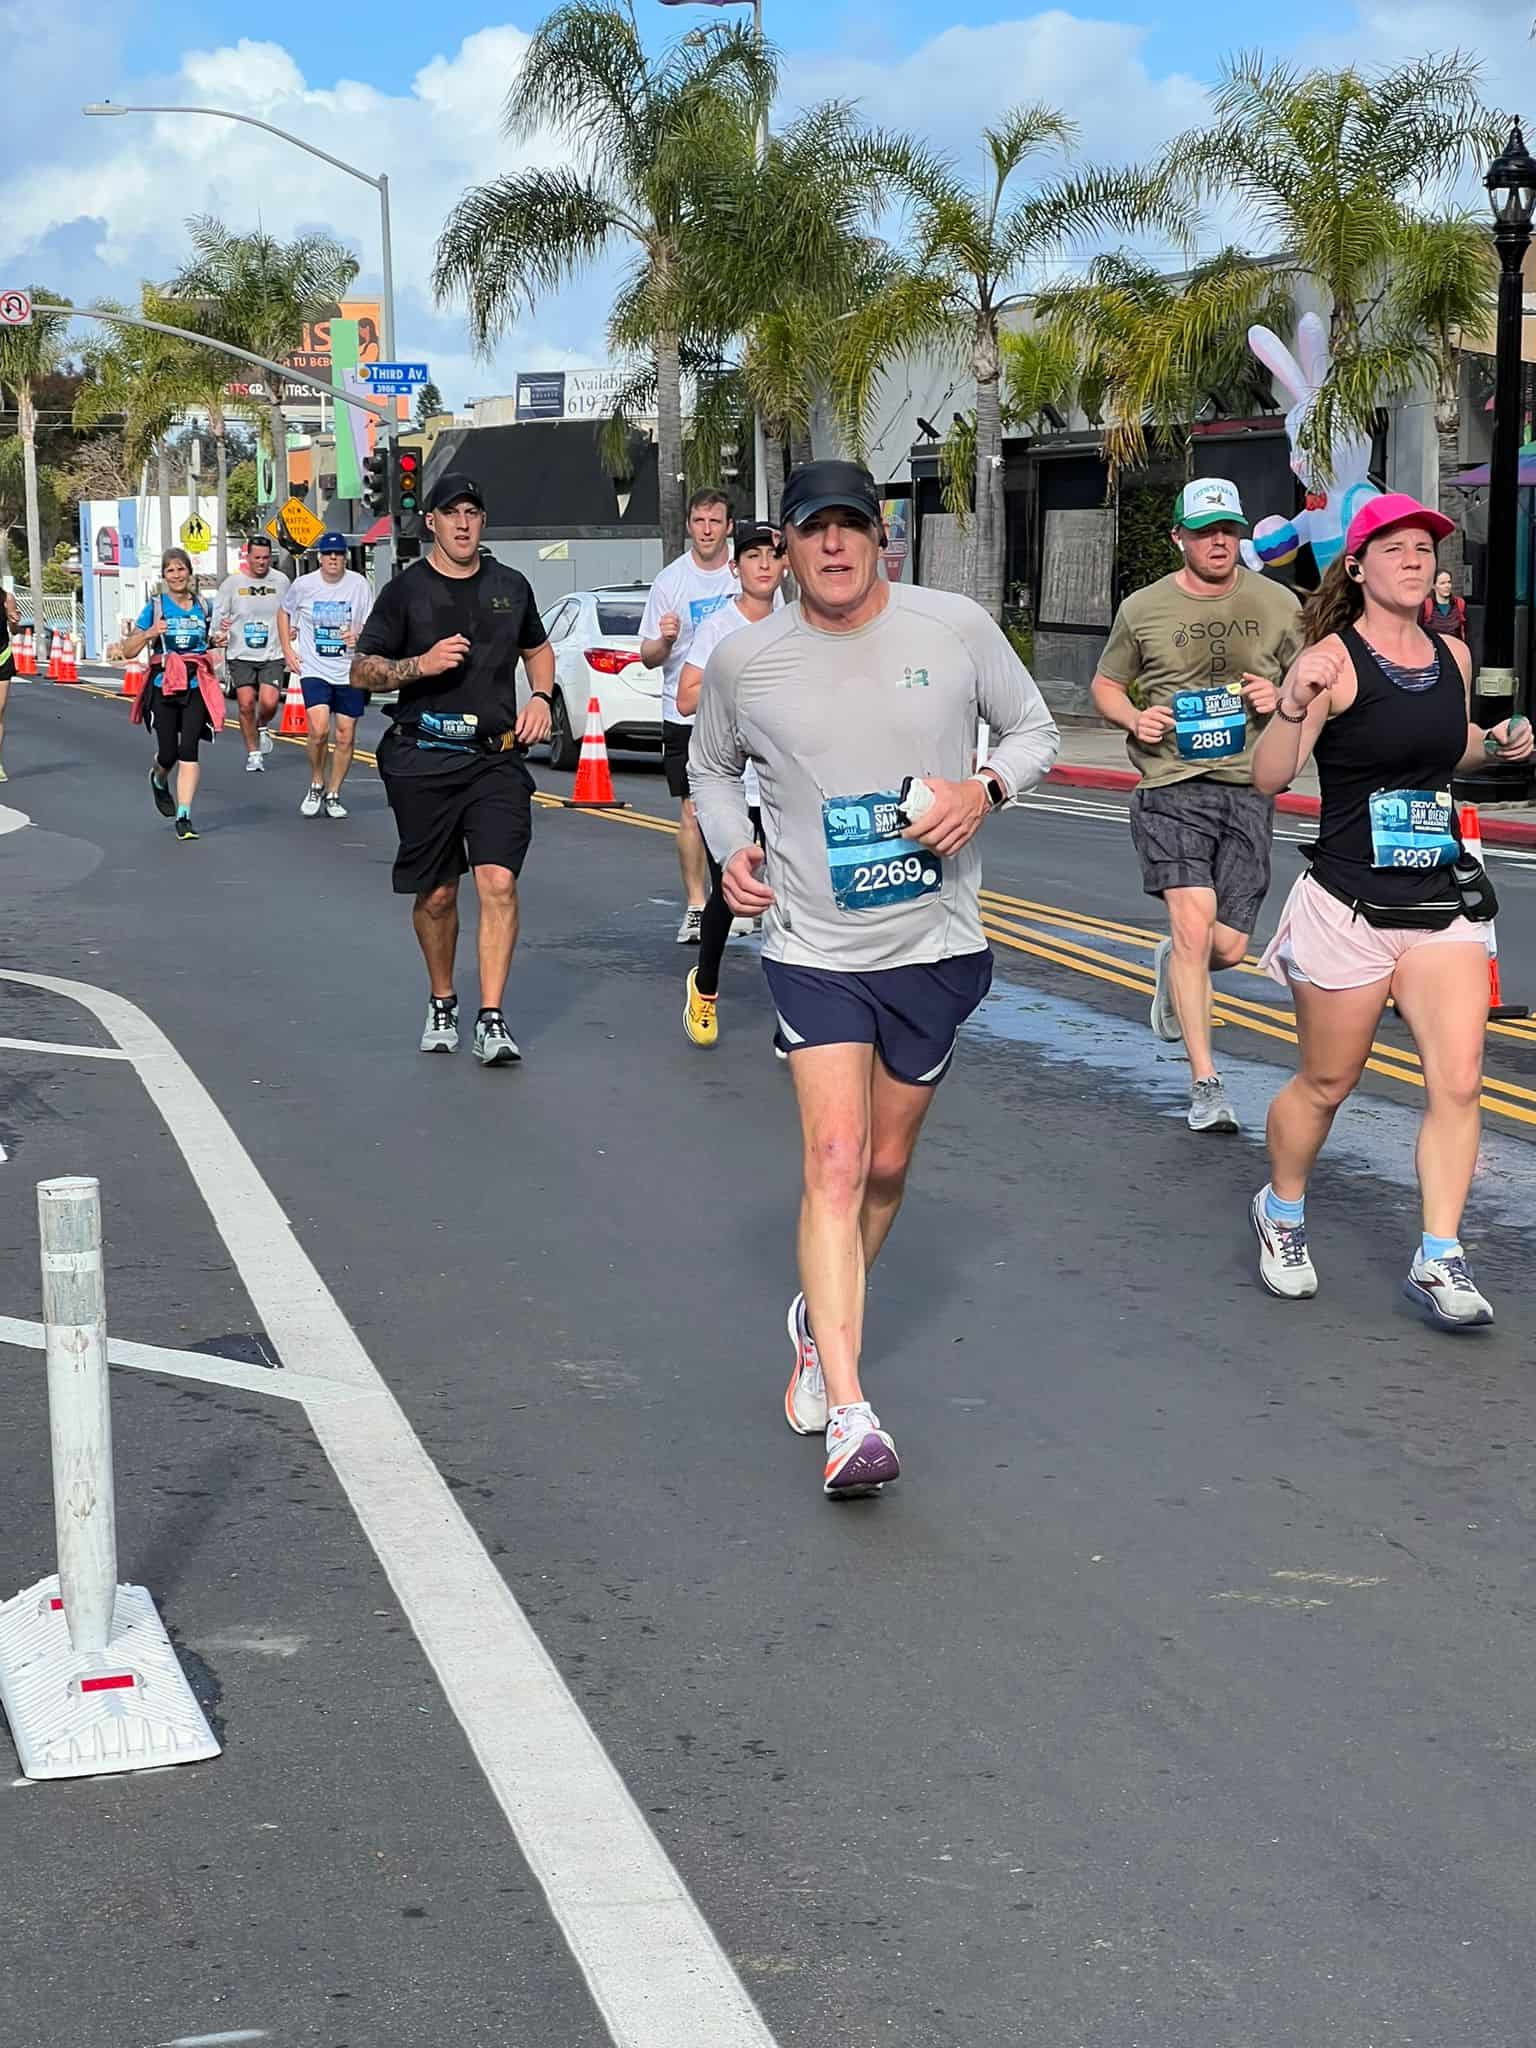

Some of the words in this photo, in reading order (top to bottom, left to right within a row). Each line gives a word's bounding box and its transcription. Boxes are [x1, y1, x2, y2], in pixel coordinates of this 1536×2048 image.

[311, 357, 333, 367] BEB
[372, 367, 403, 380] THIRD
[1190, 620, 1260, 639] SOAR
[1192, 729, 1231, 749] 2881
[875, 811, 898, 826] SAN
[1411, 808, 1427, 821] SAN
[1427, 809, 1449, 823] DIEGO
[1393, 847, 1441, 867] 3237
[854, 857, 922, 892] 2269
